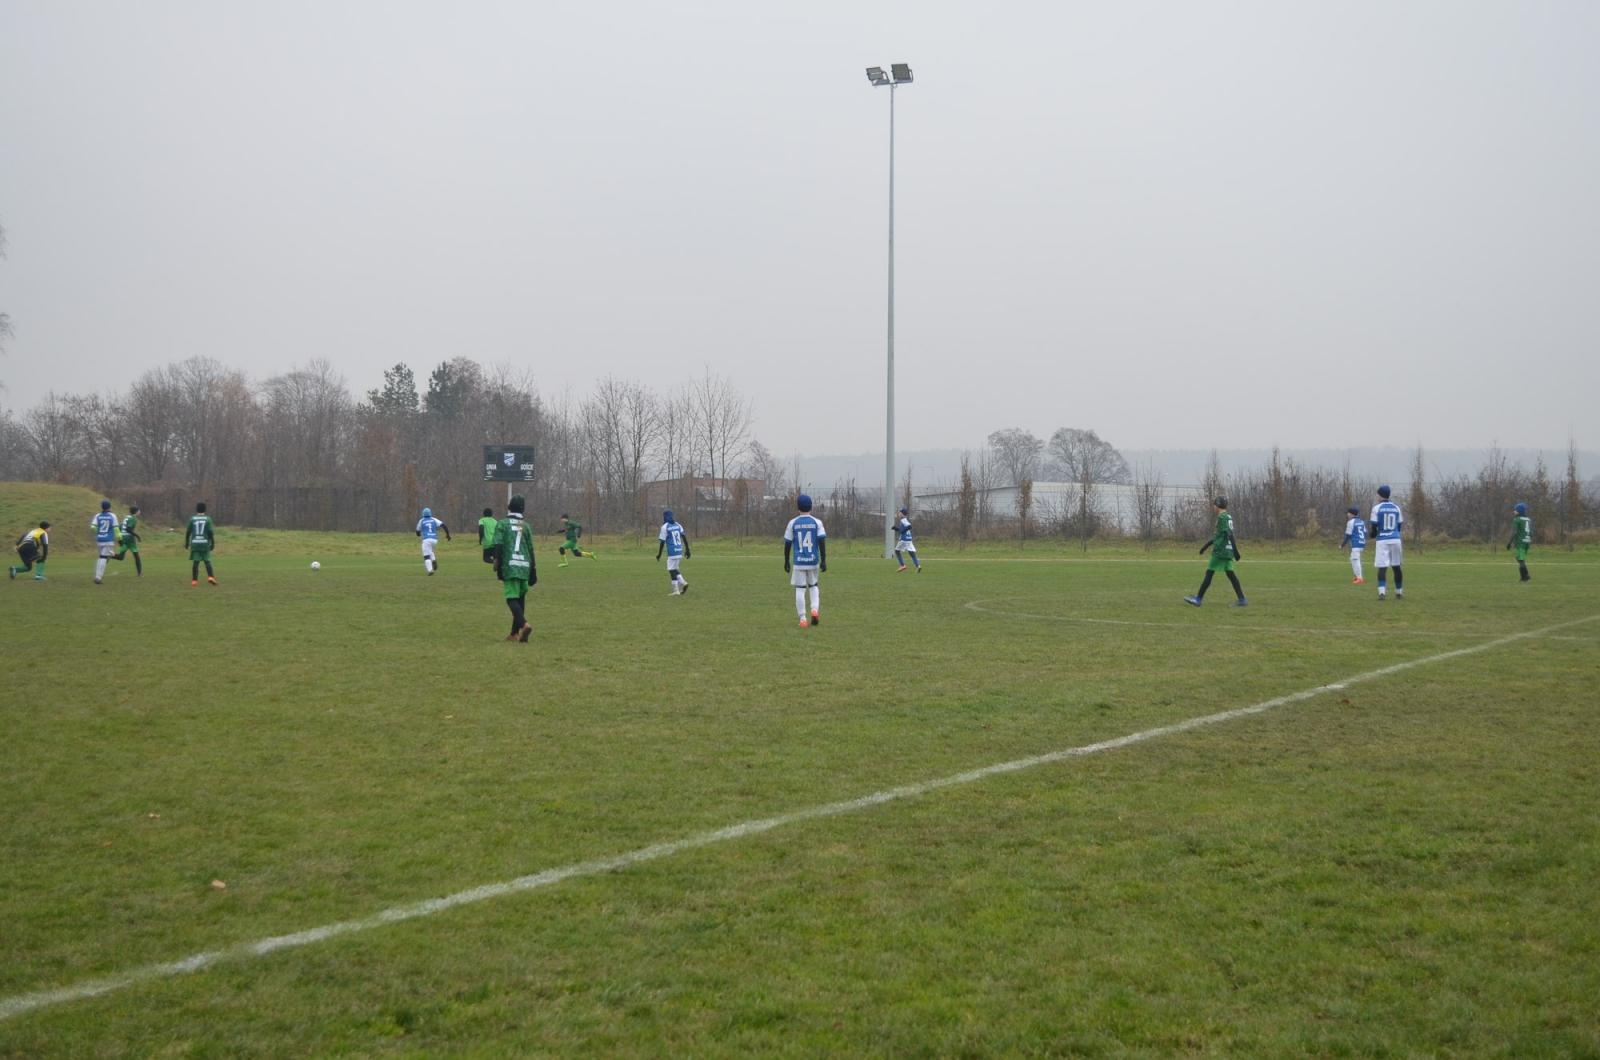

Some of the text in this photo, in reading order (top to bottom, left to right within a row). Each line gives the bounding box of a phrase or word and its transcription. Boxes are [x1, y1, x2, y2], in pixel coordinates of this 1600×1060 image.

[99, 519, 110, 533] 21
[193, 520, 206, 535] 17
[1383, 513, 1396, 531] 10
[511, 525, 523, 552] 7
[671, 530, 682, 546] 13
[797, 531, 813, 553] 14
